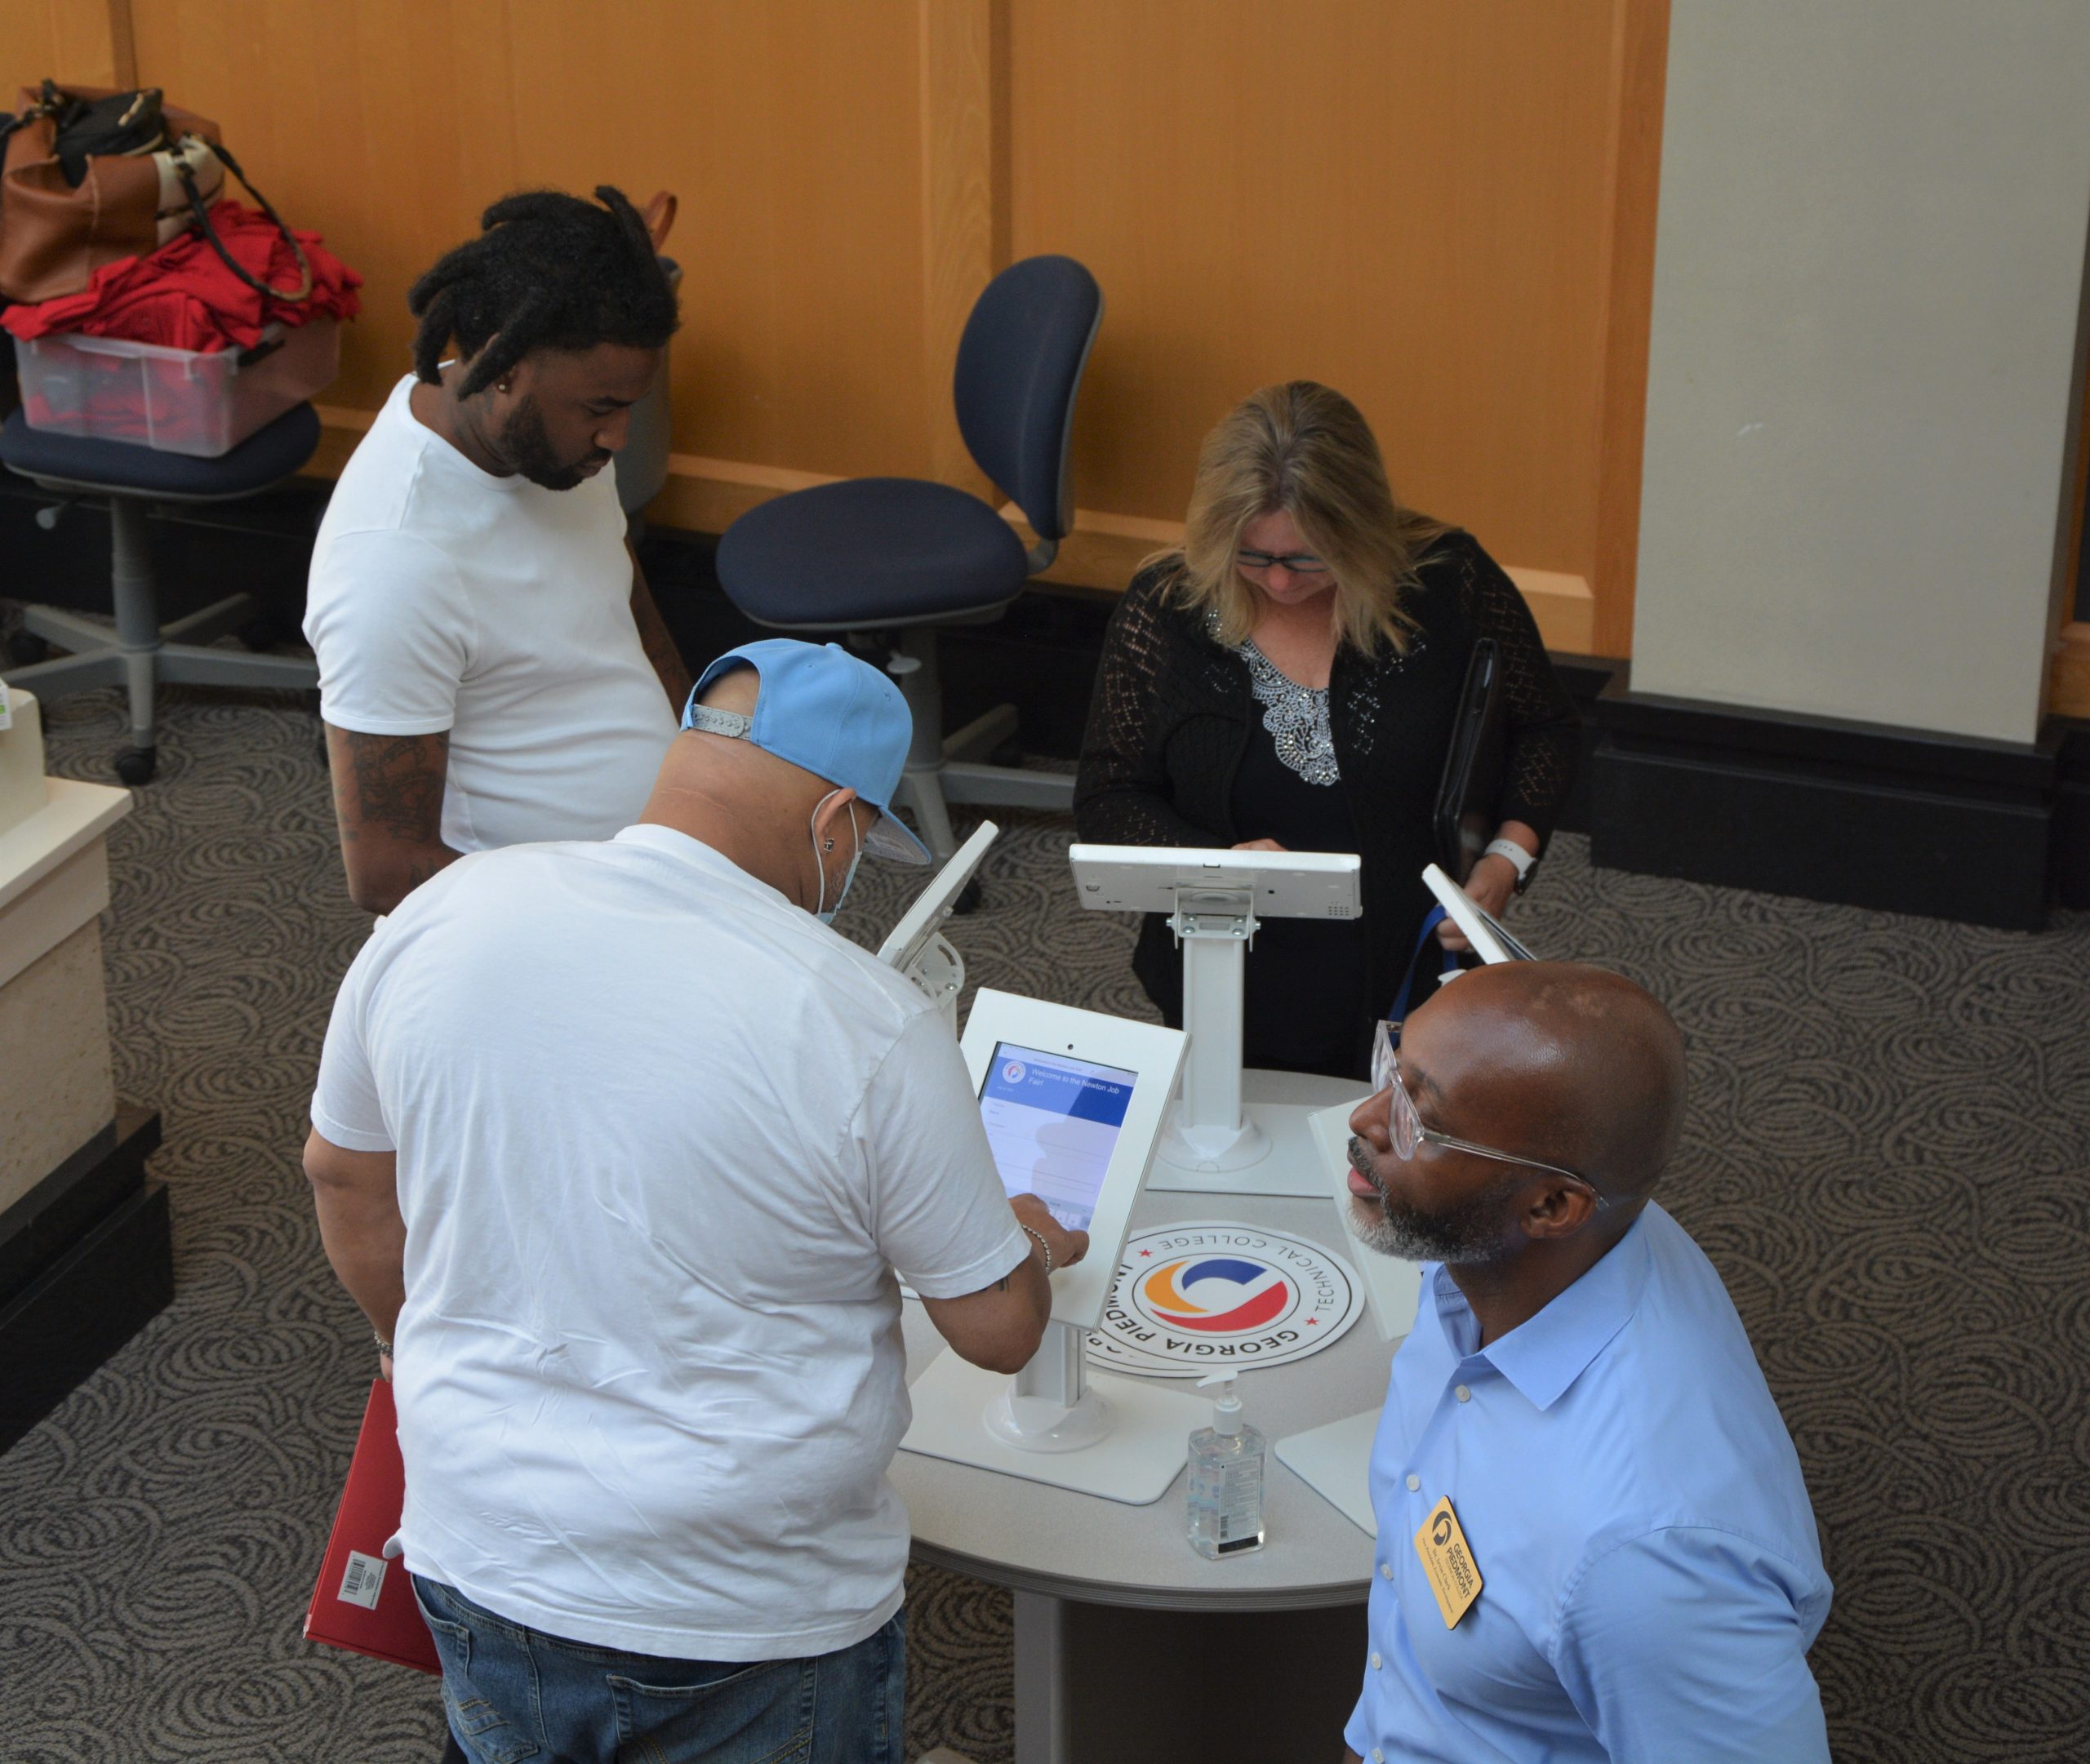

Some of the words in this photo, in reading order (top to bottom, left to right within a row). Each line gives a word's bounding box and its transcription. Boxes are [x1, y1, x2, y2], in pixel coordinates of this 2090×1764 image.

[1028, 1078, 1043, 1087] Fair!
[1031, 1067, 1061, 1082] Welcome
[1070, 1077, 1081, 1086] the
[1082, 1079, 1106, 1091] Newton
[1106, 1086, 1120, 1095] Job
[1158, 1234, 1267, 1251] COLLEGE
[1278, 1245, 1335, 1313] TECHNICAL
[1165, 1330, 1300, 1357] GEORGIA
[1446, 1547, 1470, 1598] PIEDMONT
[1453, 1543, 1474, 1588] GEORGIA
